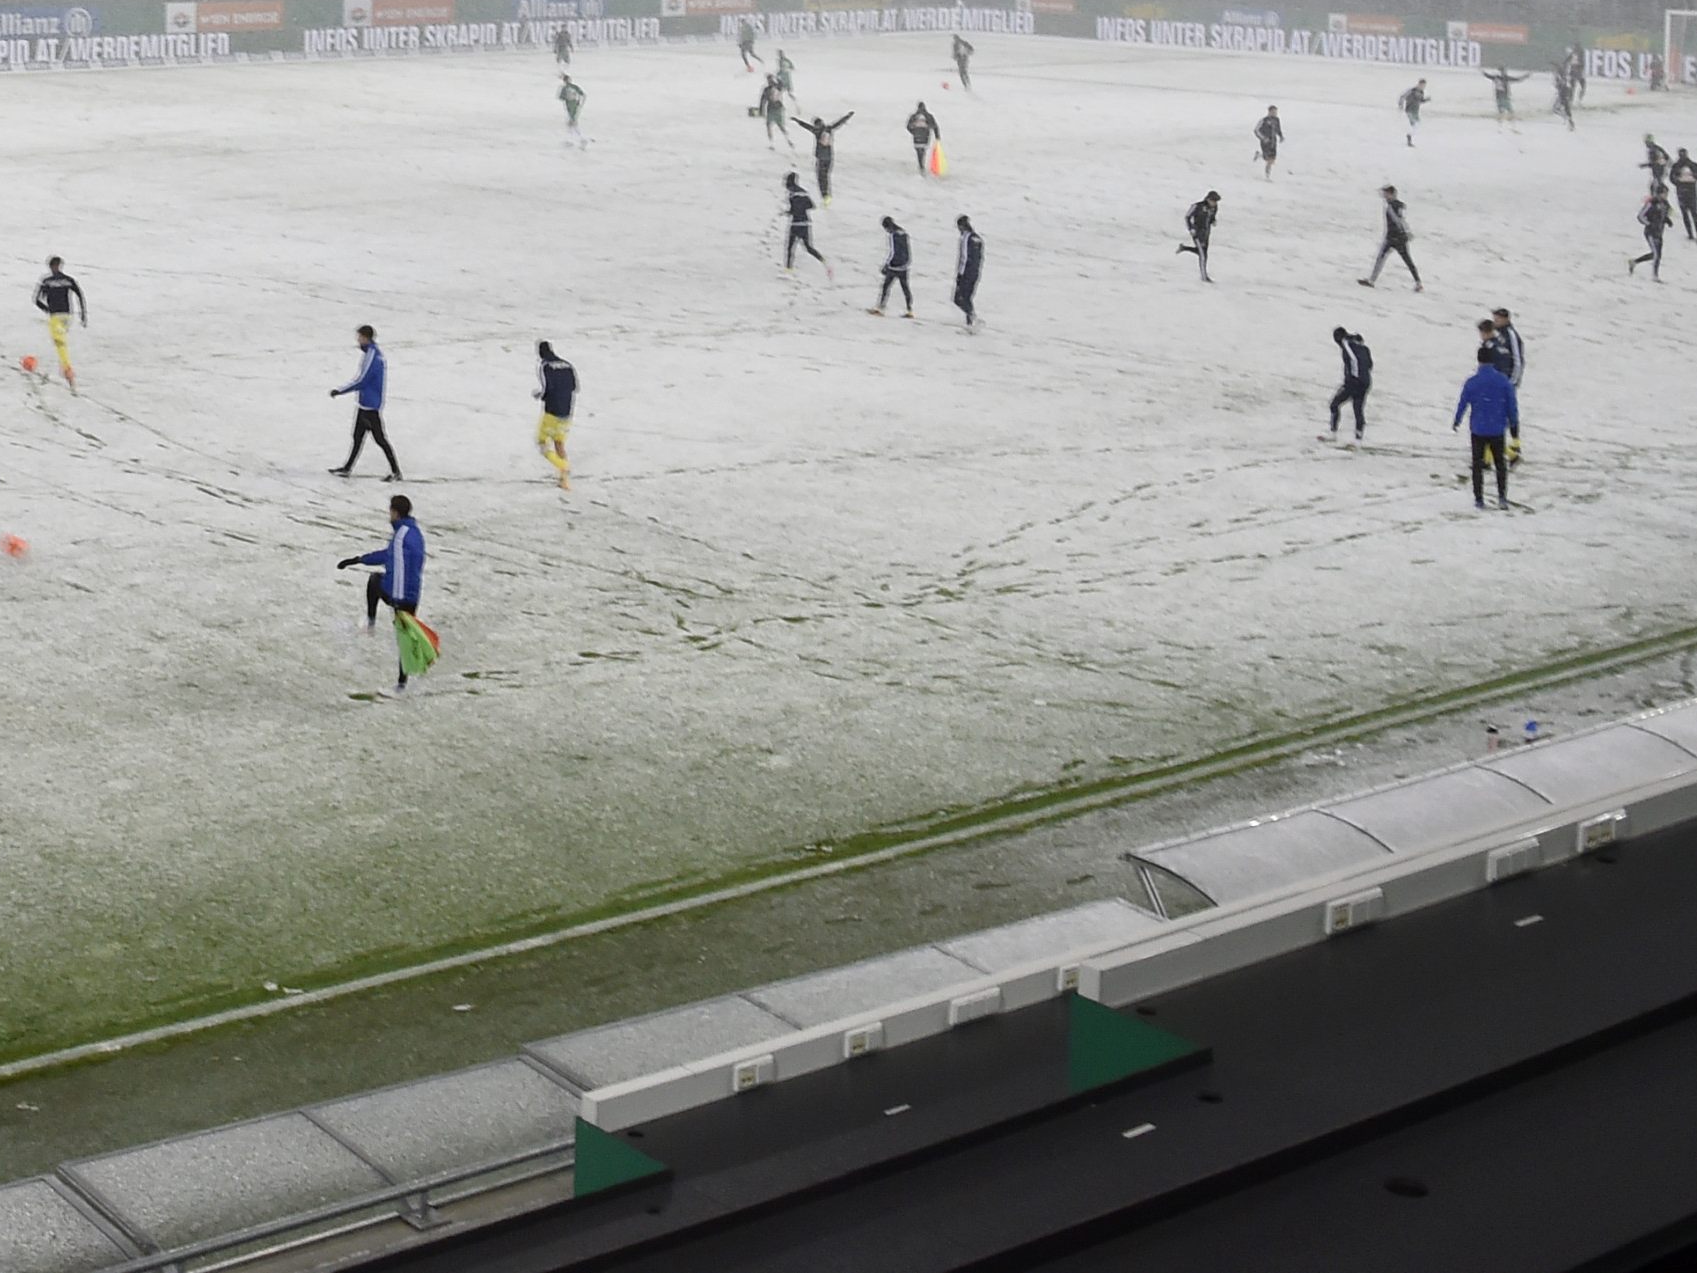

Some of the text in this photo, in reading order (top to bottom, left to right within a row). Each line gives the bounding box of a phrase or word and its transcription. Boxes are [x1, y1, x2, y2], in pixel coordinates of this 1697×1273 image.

[304, 27, 359, 53] INFOS
[1095, 16, 1146, 43] INFOS
[1151, 19, 1204, 49] UNTER
